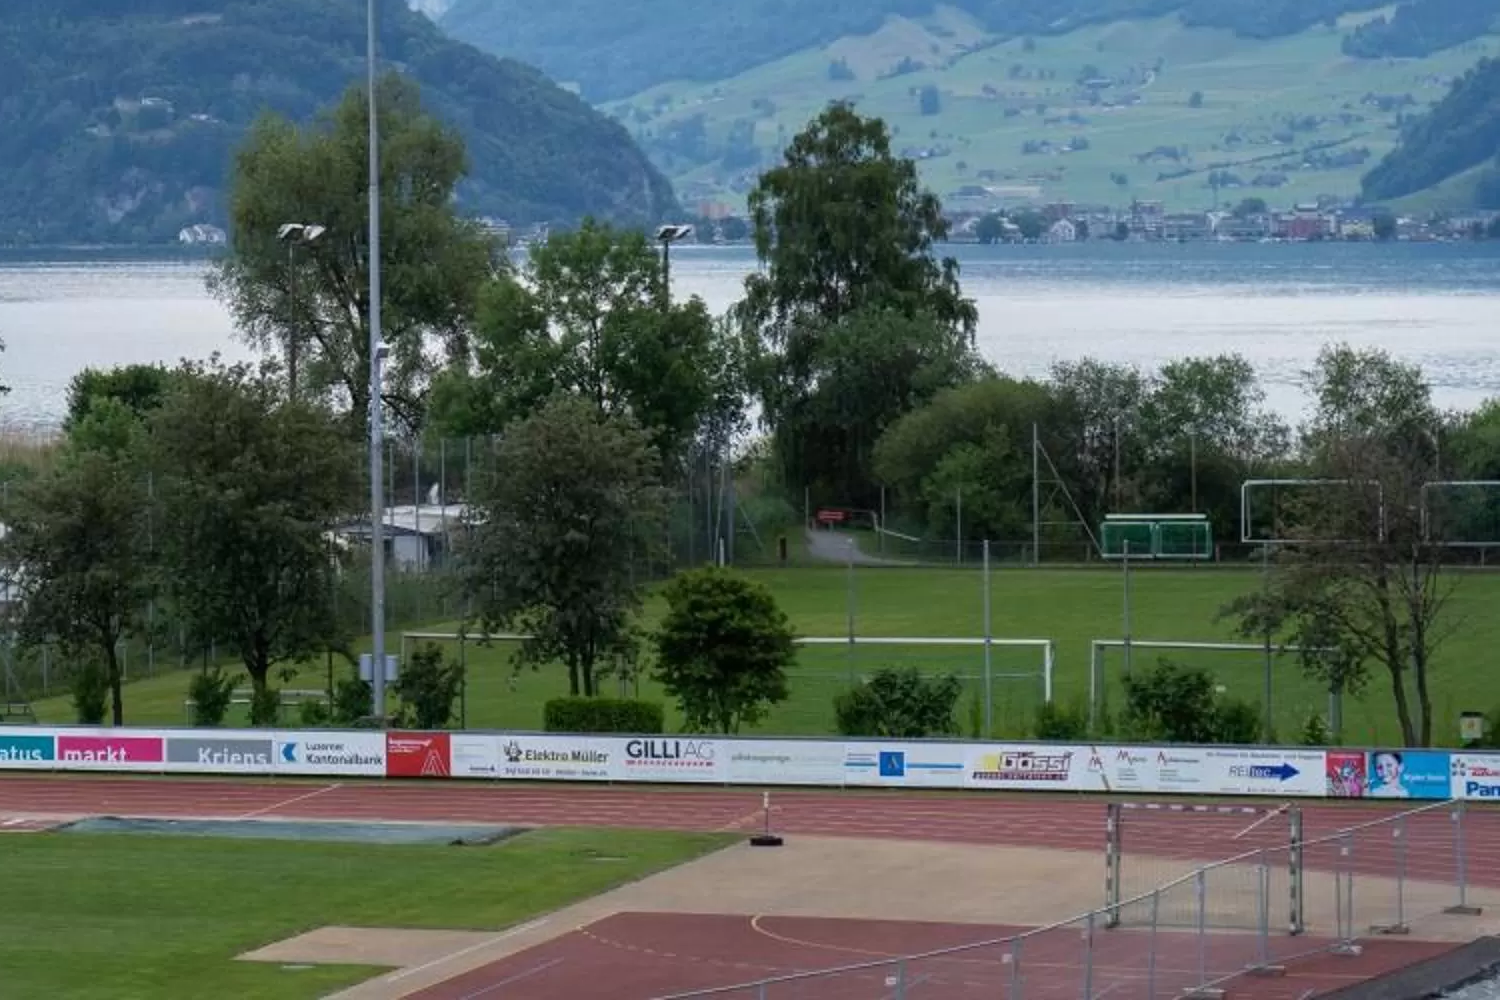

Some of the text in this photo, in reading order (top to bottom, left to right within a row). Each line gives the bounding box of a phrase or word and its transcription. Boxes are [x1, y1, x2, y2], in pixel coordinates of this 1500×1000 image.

[64, 746, 131, 762] markt
[198, 748, 268, 765] Kriens
[525, 749, 568, 761] Elektro
[626, 740, 680, 758] GILLI
[684, 741, 714, 759] AG
[305, 754, 383, 766] Kantonalbank
